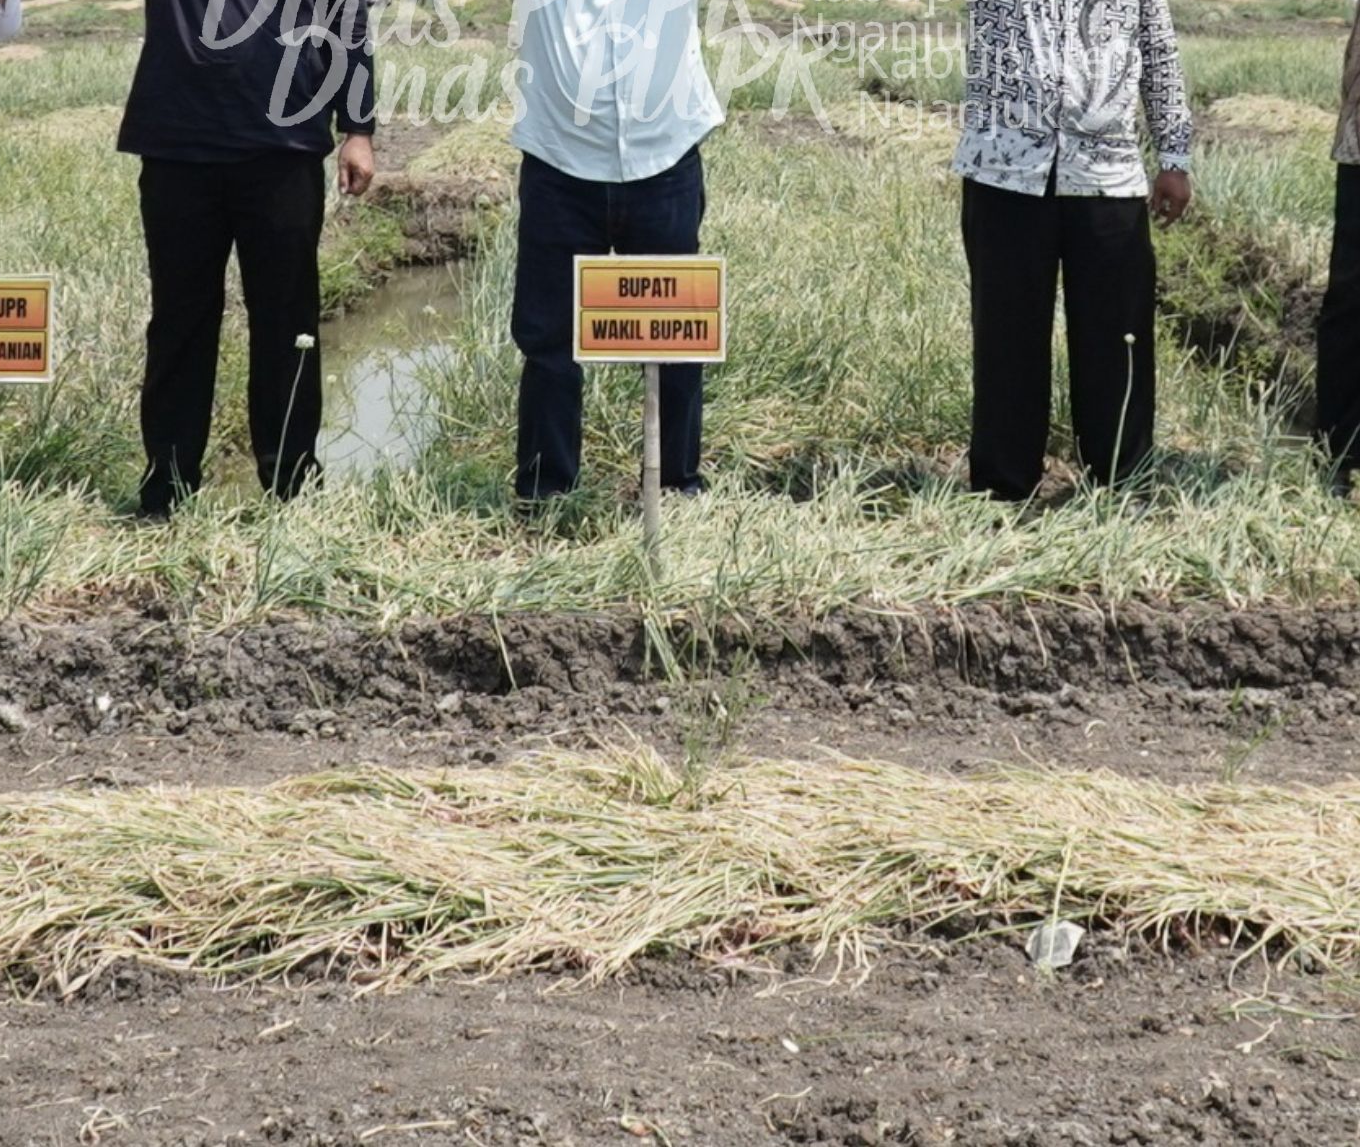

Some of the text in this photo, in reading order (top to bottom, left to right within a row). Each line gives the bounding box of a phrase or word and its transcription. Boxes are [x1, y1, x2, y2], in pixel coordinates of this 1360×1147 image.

[618, 276, 677, 298] BUPATI
[591, 318, 708, 341] WAKIL BUPATI
